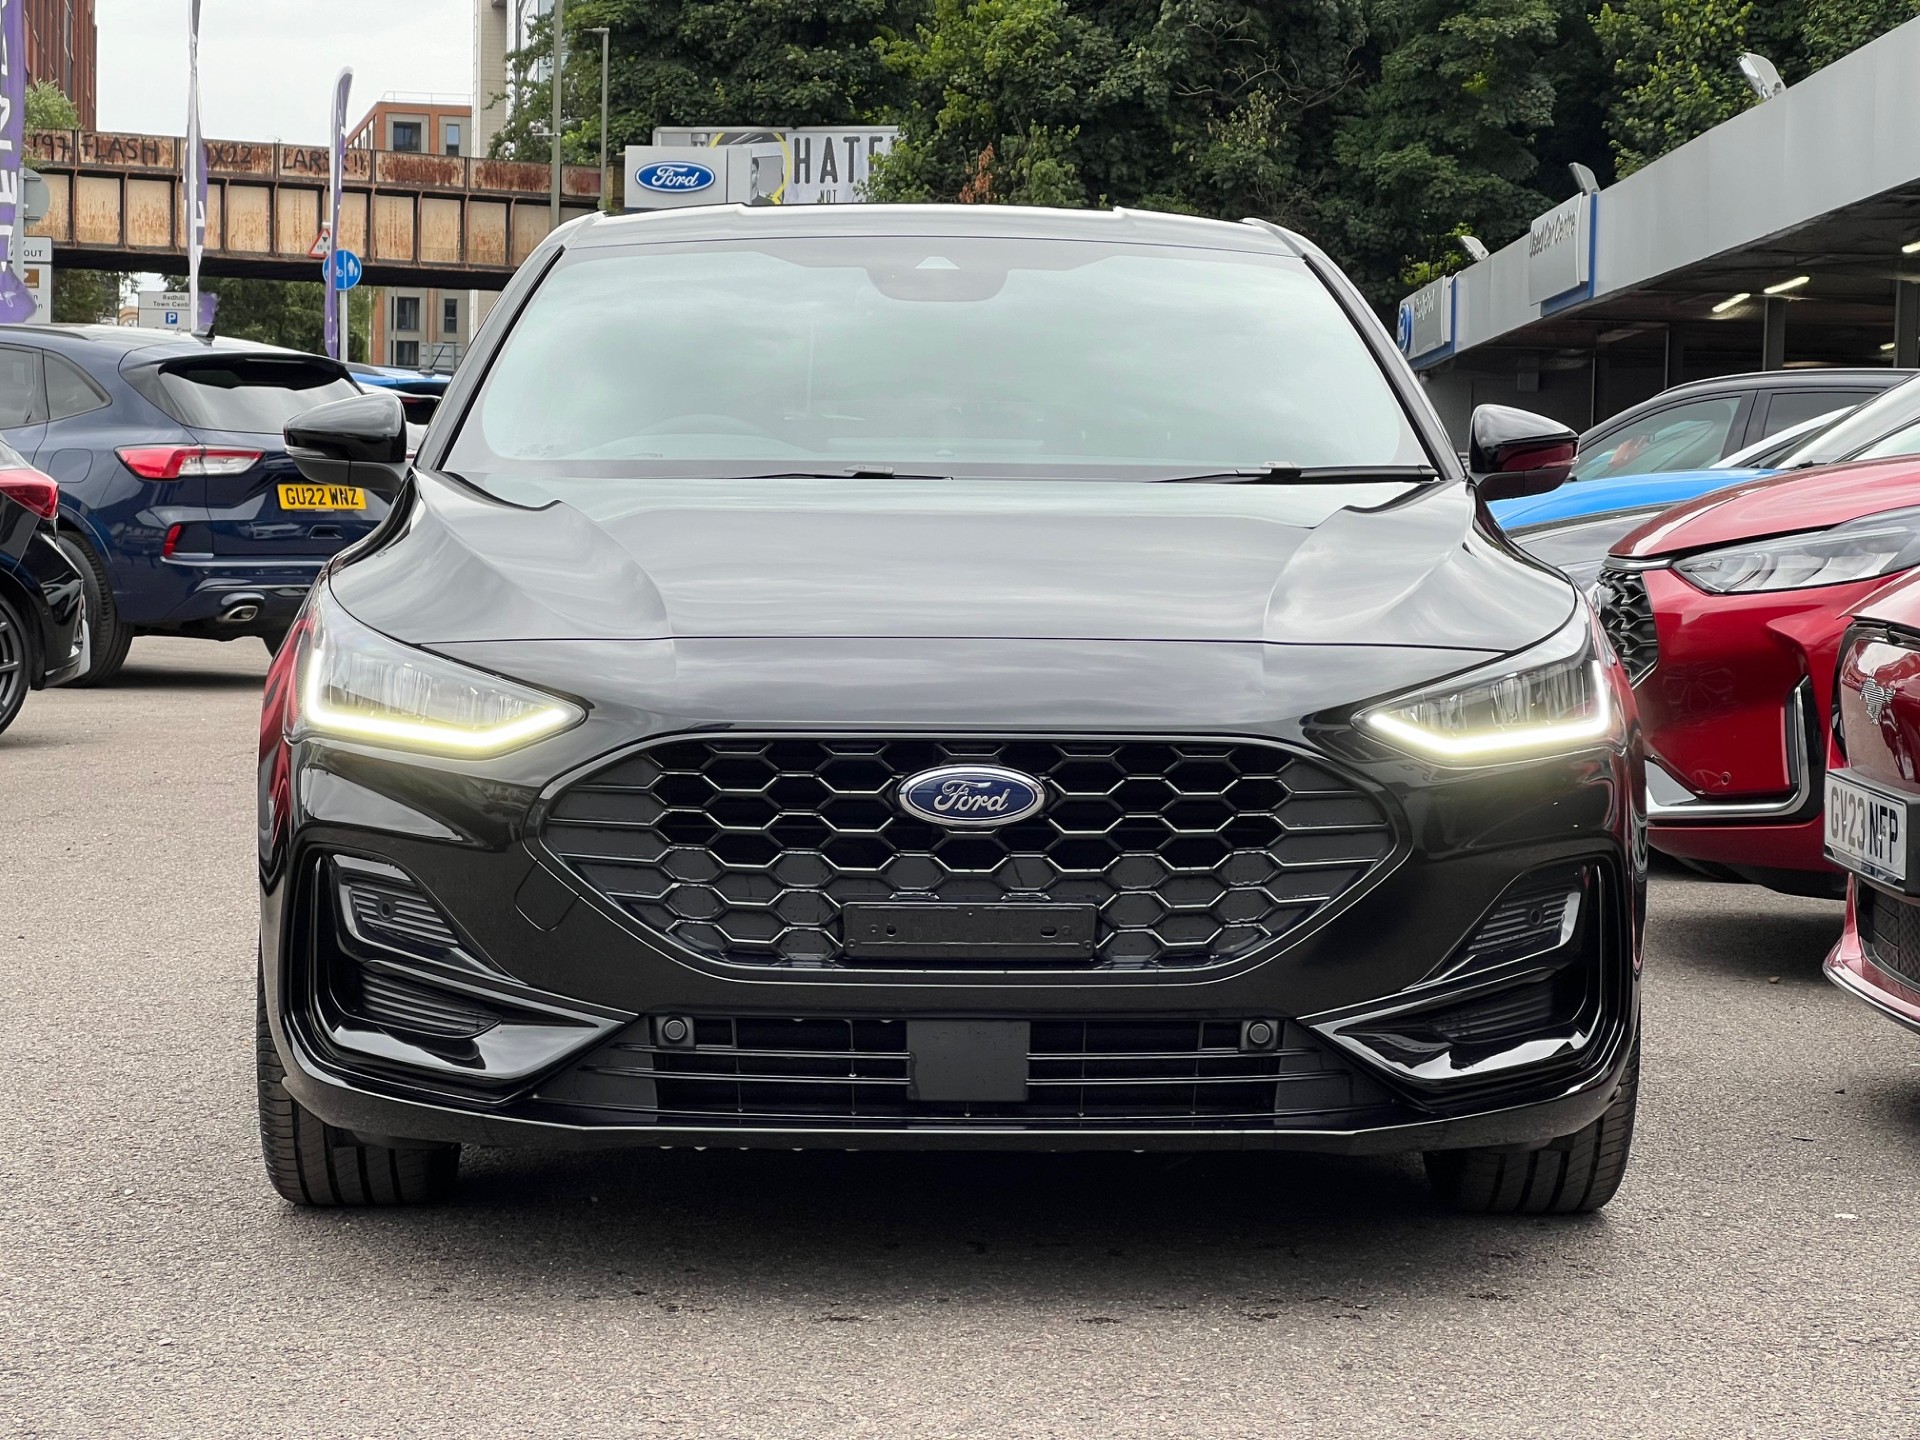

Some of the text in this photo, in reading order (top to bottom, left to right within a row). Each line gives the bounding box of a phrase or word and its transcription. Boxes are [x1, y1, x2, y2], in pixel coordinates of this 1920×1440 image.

[81, 133, 161, 164] FLASH
[651, 165, 700, 187] Ford
[286, 487, 359, 506] GU22 WNZ
[933, 780, 1011, 812] Ford
[1869, 801, 1898, 863] NFP
